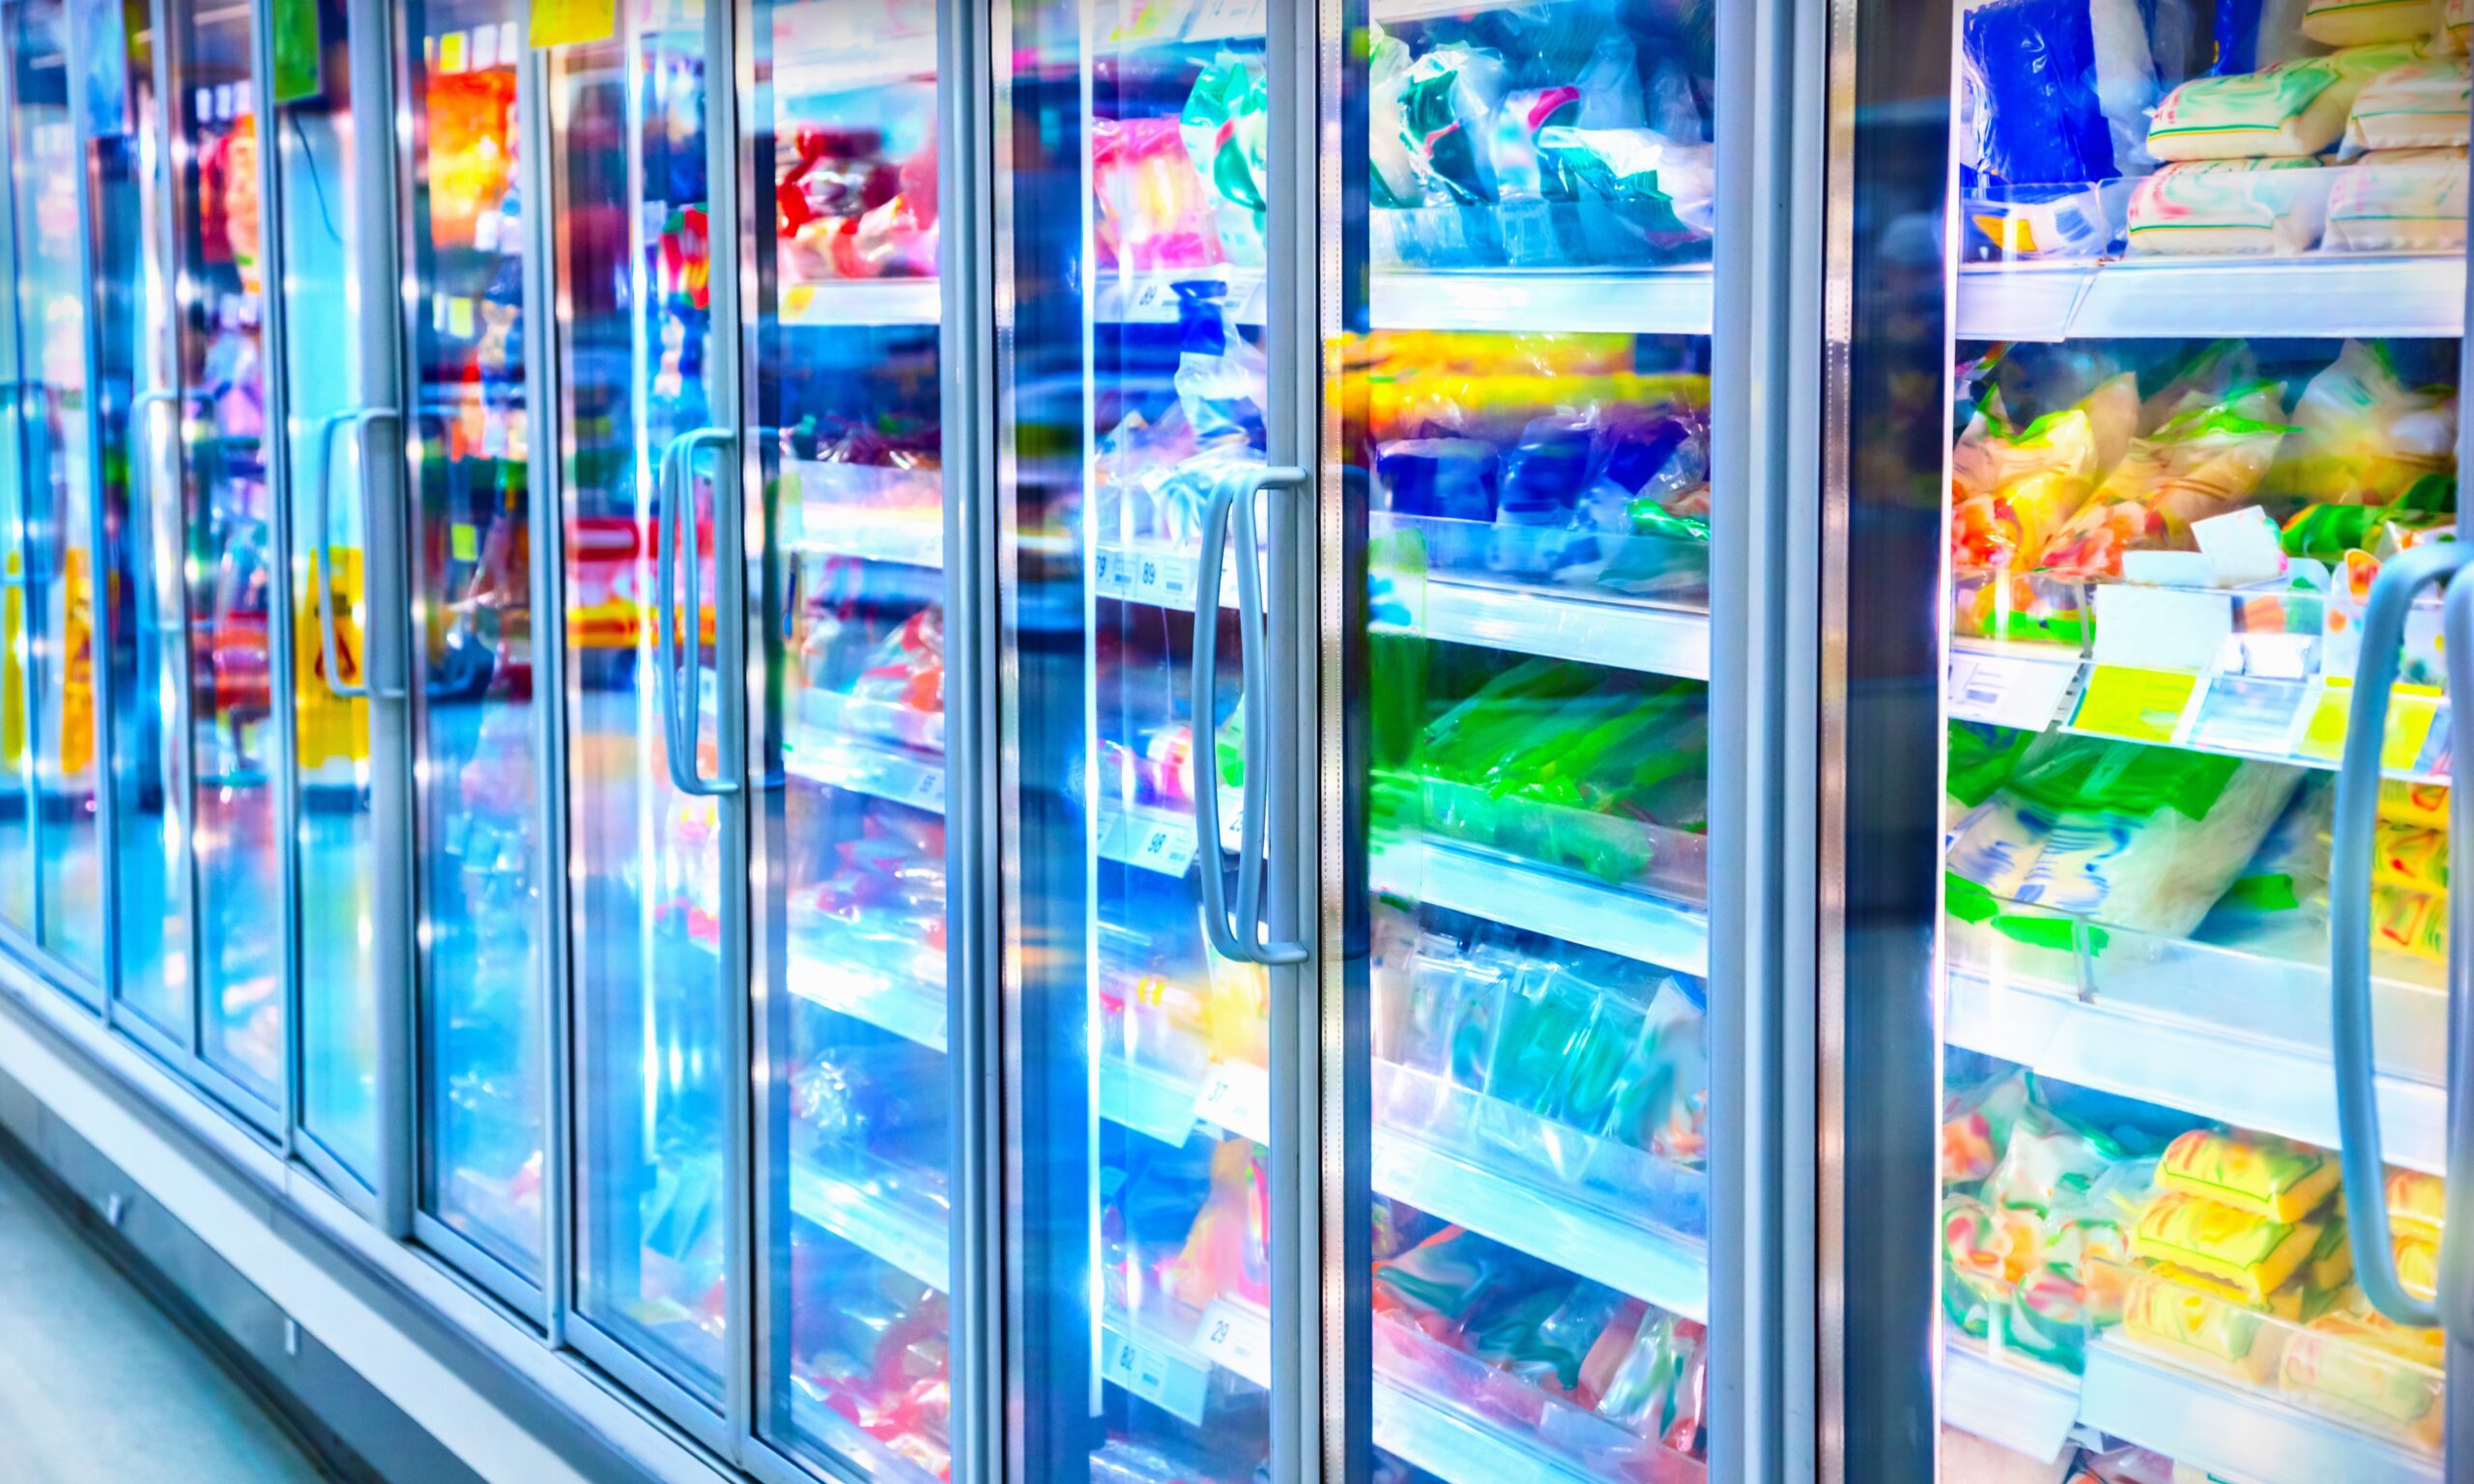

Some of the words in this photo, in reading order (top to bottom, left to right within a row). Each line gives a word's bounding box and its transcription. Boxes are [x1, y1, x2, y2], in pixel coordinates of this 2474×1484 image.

[1142, 562, 1156, 585] 89
[1147, 833, 1166, 853] 98
[1210, 1320, 1229, 1344] 29
